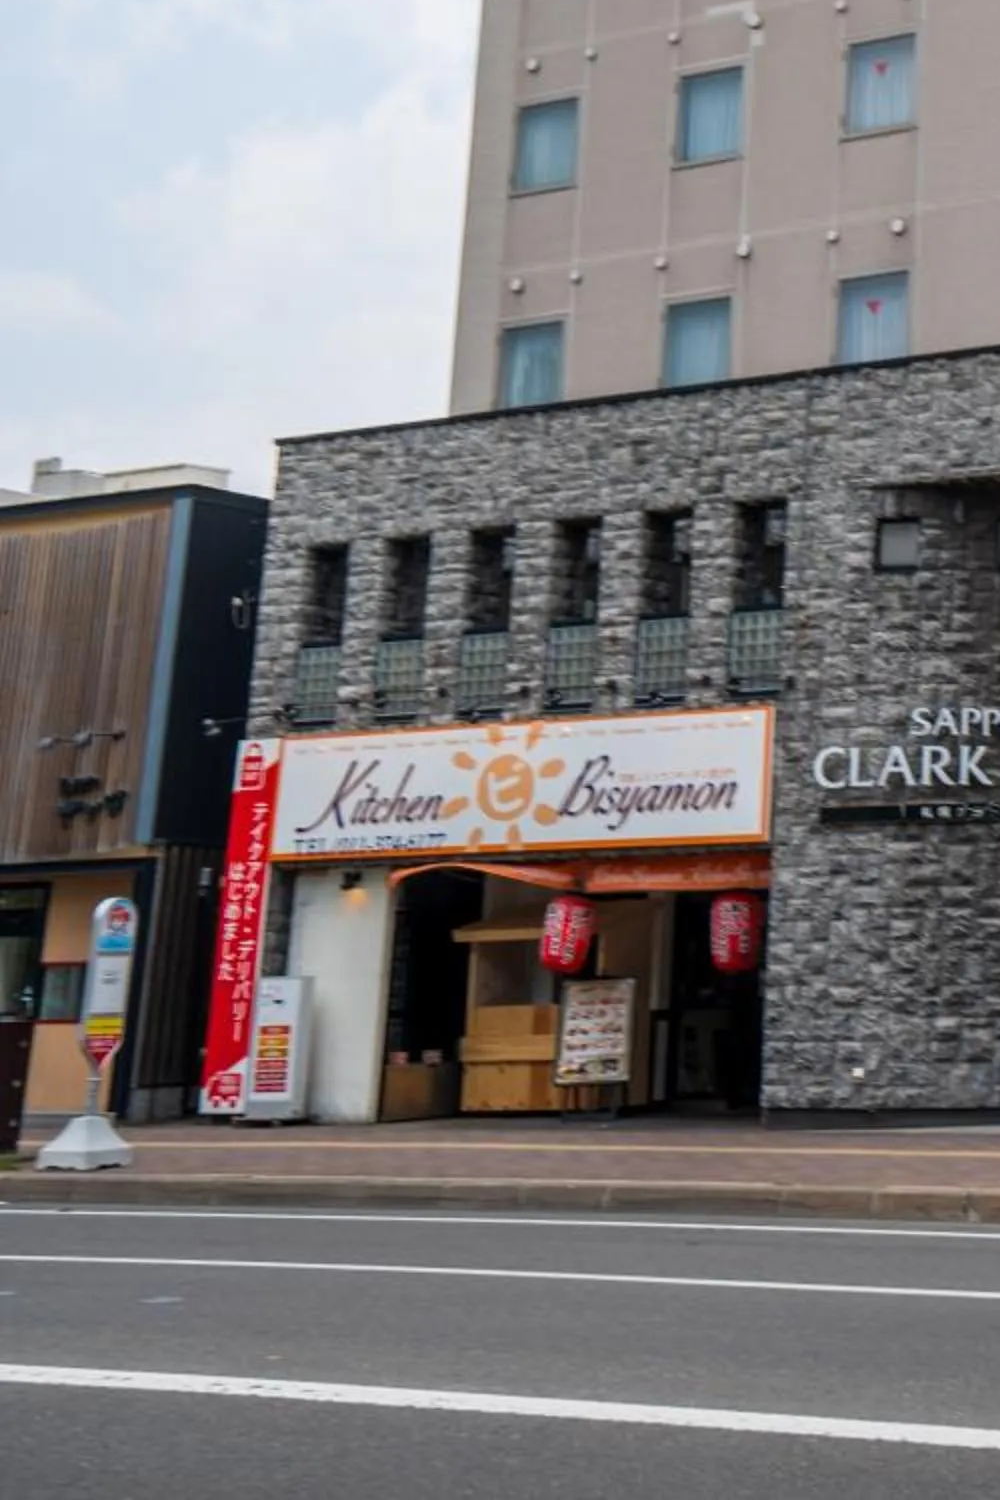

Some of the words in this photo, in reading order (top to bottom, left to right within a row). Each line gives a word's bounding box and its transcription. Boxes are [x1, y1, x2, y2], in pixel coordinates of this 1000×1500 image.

[295, 759, 443, 833] Kitchen
[557, 754, 738, 831] Bisyamon
[812, 745, 995, 789] CLARK
